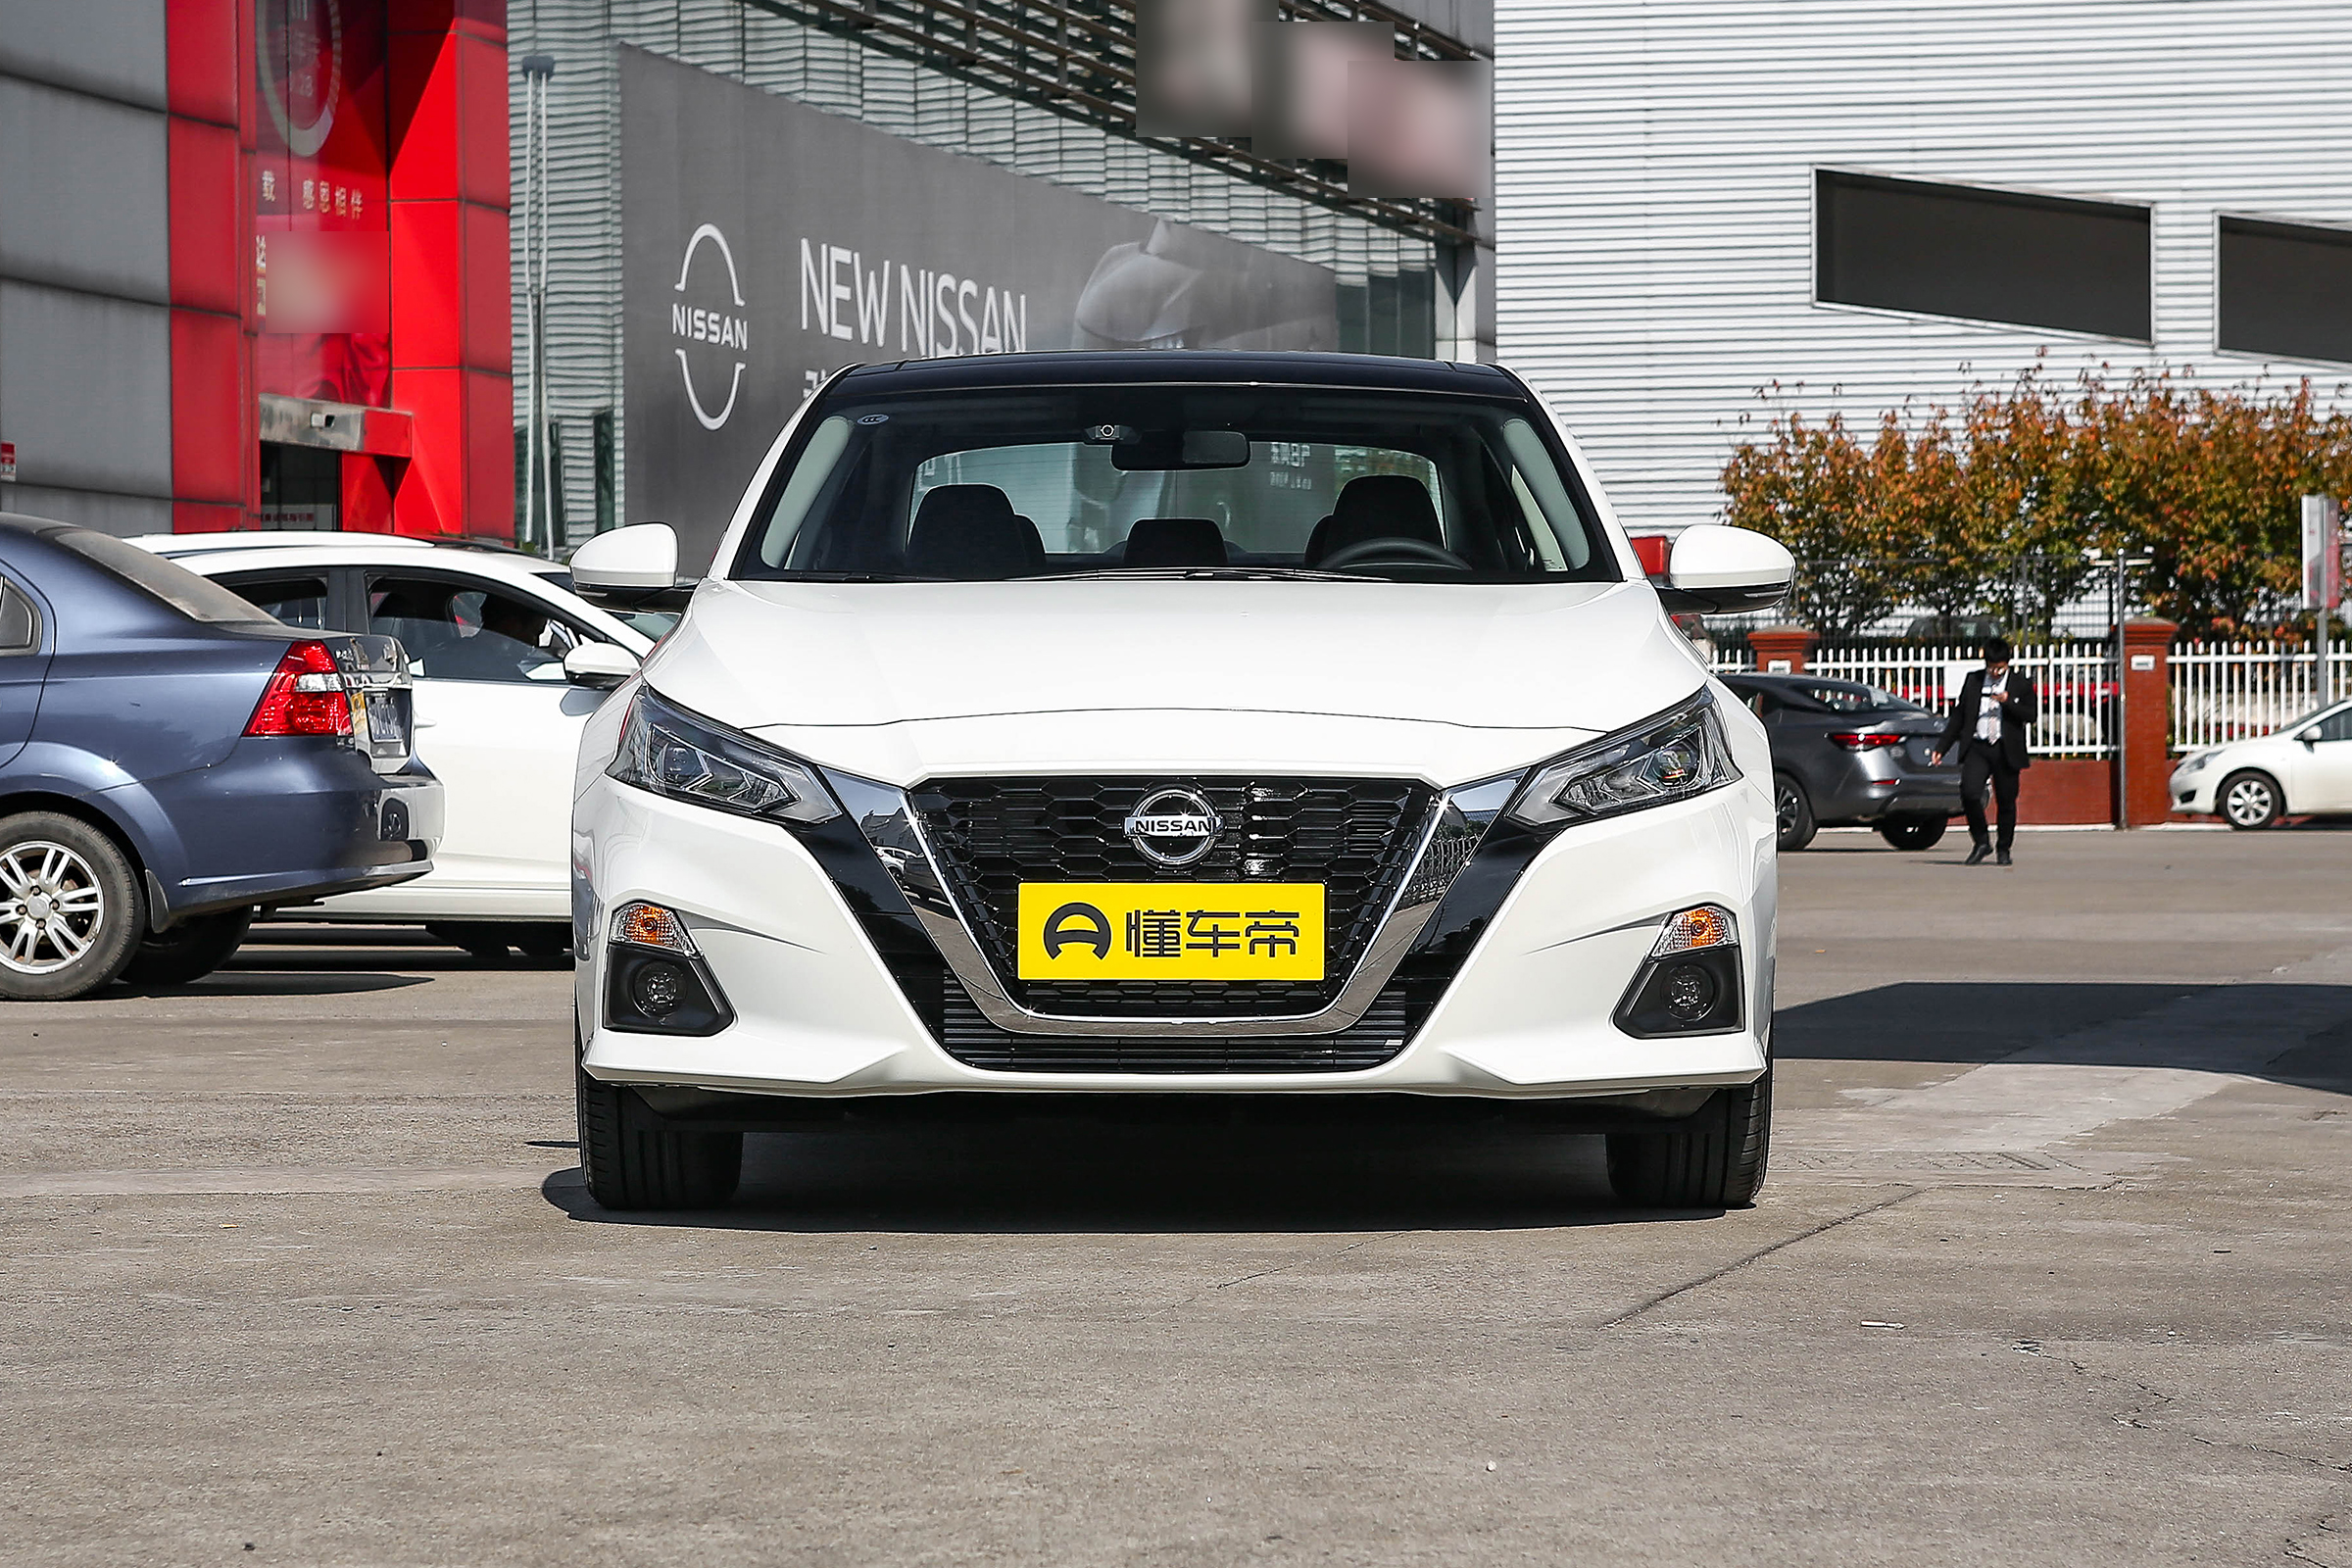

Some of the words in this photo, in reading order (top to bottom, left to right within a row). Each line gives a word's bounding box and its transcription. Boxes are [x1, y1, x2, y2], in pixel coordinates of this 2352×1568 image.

[800, 237, 891, 348] NEW
[900, 264, 1027, 359] NISSAN
[671, 302, 748, 352] NISSAN
[1135, 819, 1214, 832] NISSAN
[1125, 908, 1300, 958] 懂车帝
